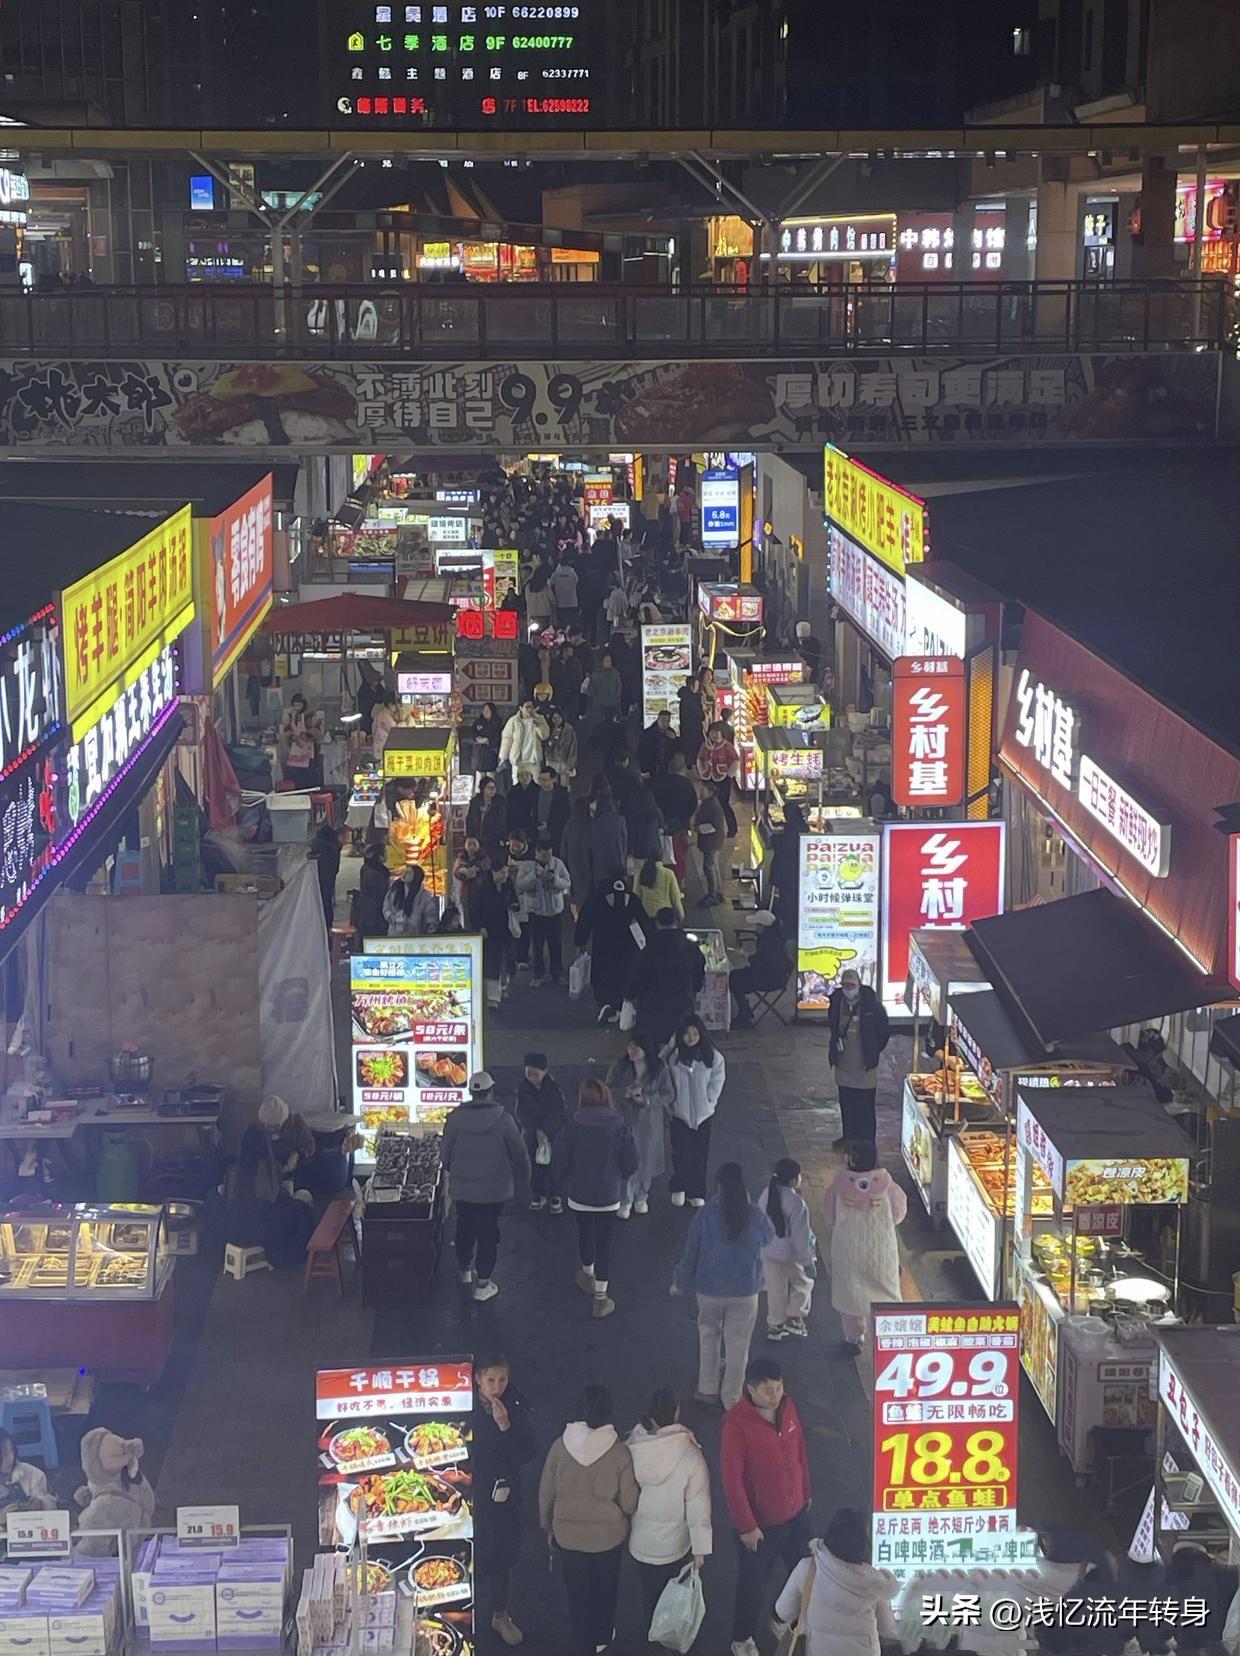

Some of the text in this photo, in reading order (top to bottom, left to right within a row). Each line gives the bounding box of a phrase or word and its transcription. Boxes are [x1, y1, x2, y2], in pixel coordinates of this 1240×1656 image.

[484, 6, 506, 18] 10F
[512, 6, 579, 19] 66220899
[485, 36, 506, 50] 9F
[512, 36, 573, 49] 62400777
[542, 69, 589, 79] 62337771
[356, 402, 494, 428] 厚待自己
[910, 661, 948, 674] 乡村基
[1015, 668, 1075, 792] 乡村基
[909, 687, 950, 796] 乡村基
[772, 752, 821, 767] 烤生蚝
[919, 833, 968, 930] 乡村
[807, 893, 874, 903] 小时候弹珠堂
[875, 1352, 1008, 1398] 49.9
[927, 1403, 1007, 1420] 无限畅吃
[881, 1430, 1006, 1485] 18.8
[892, 1489, 996, 1508] 单点鱼蛙
[210, 1524, 234, 1536] 15.9
[876, 1517, 922, 1535] 足斤足两
[40, 1529, 59, 1541] 9.9
